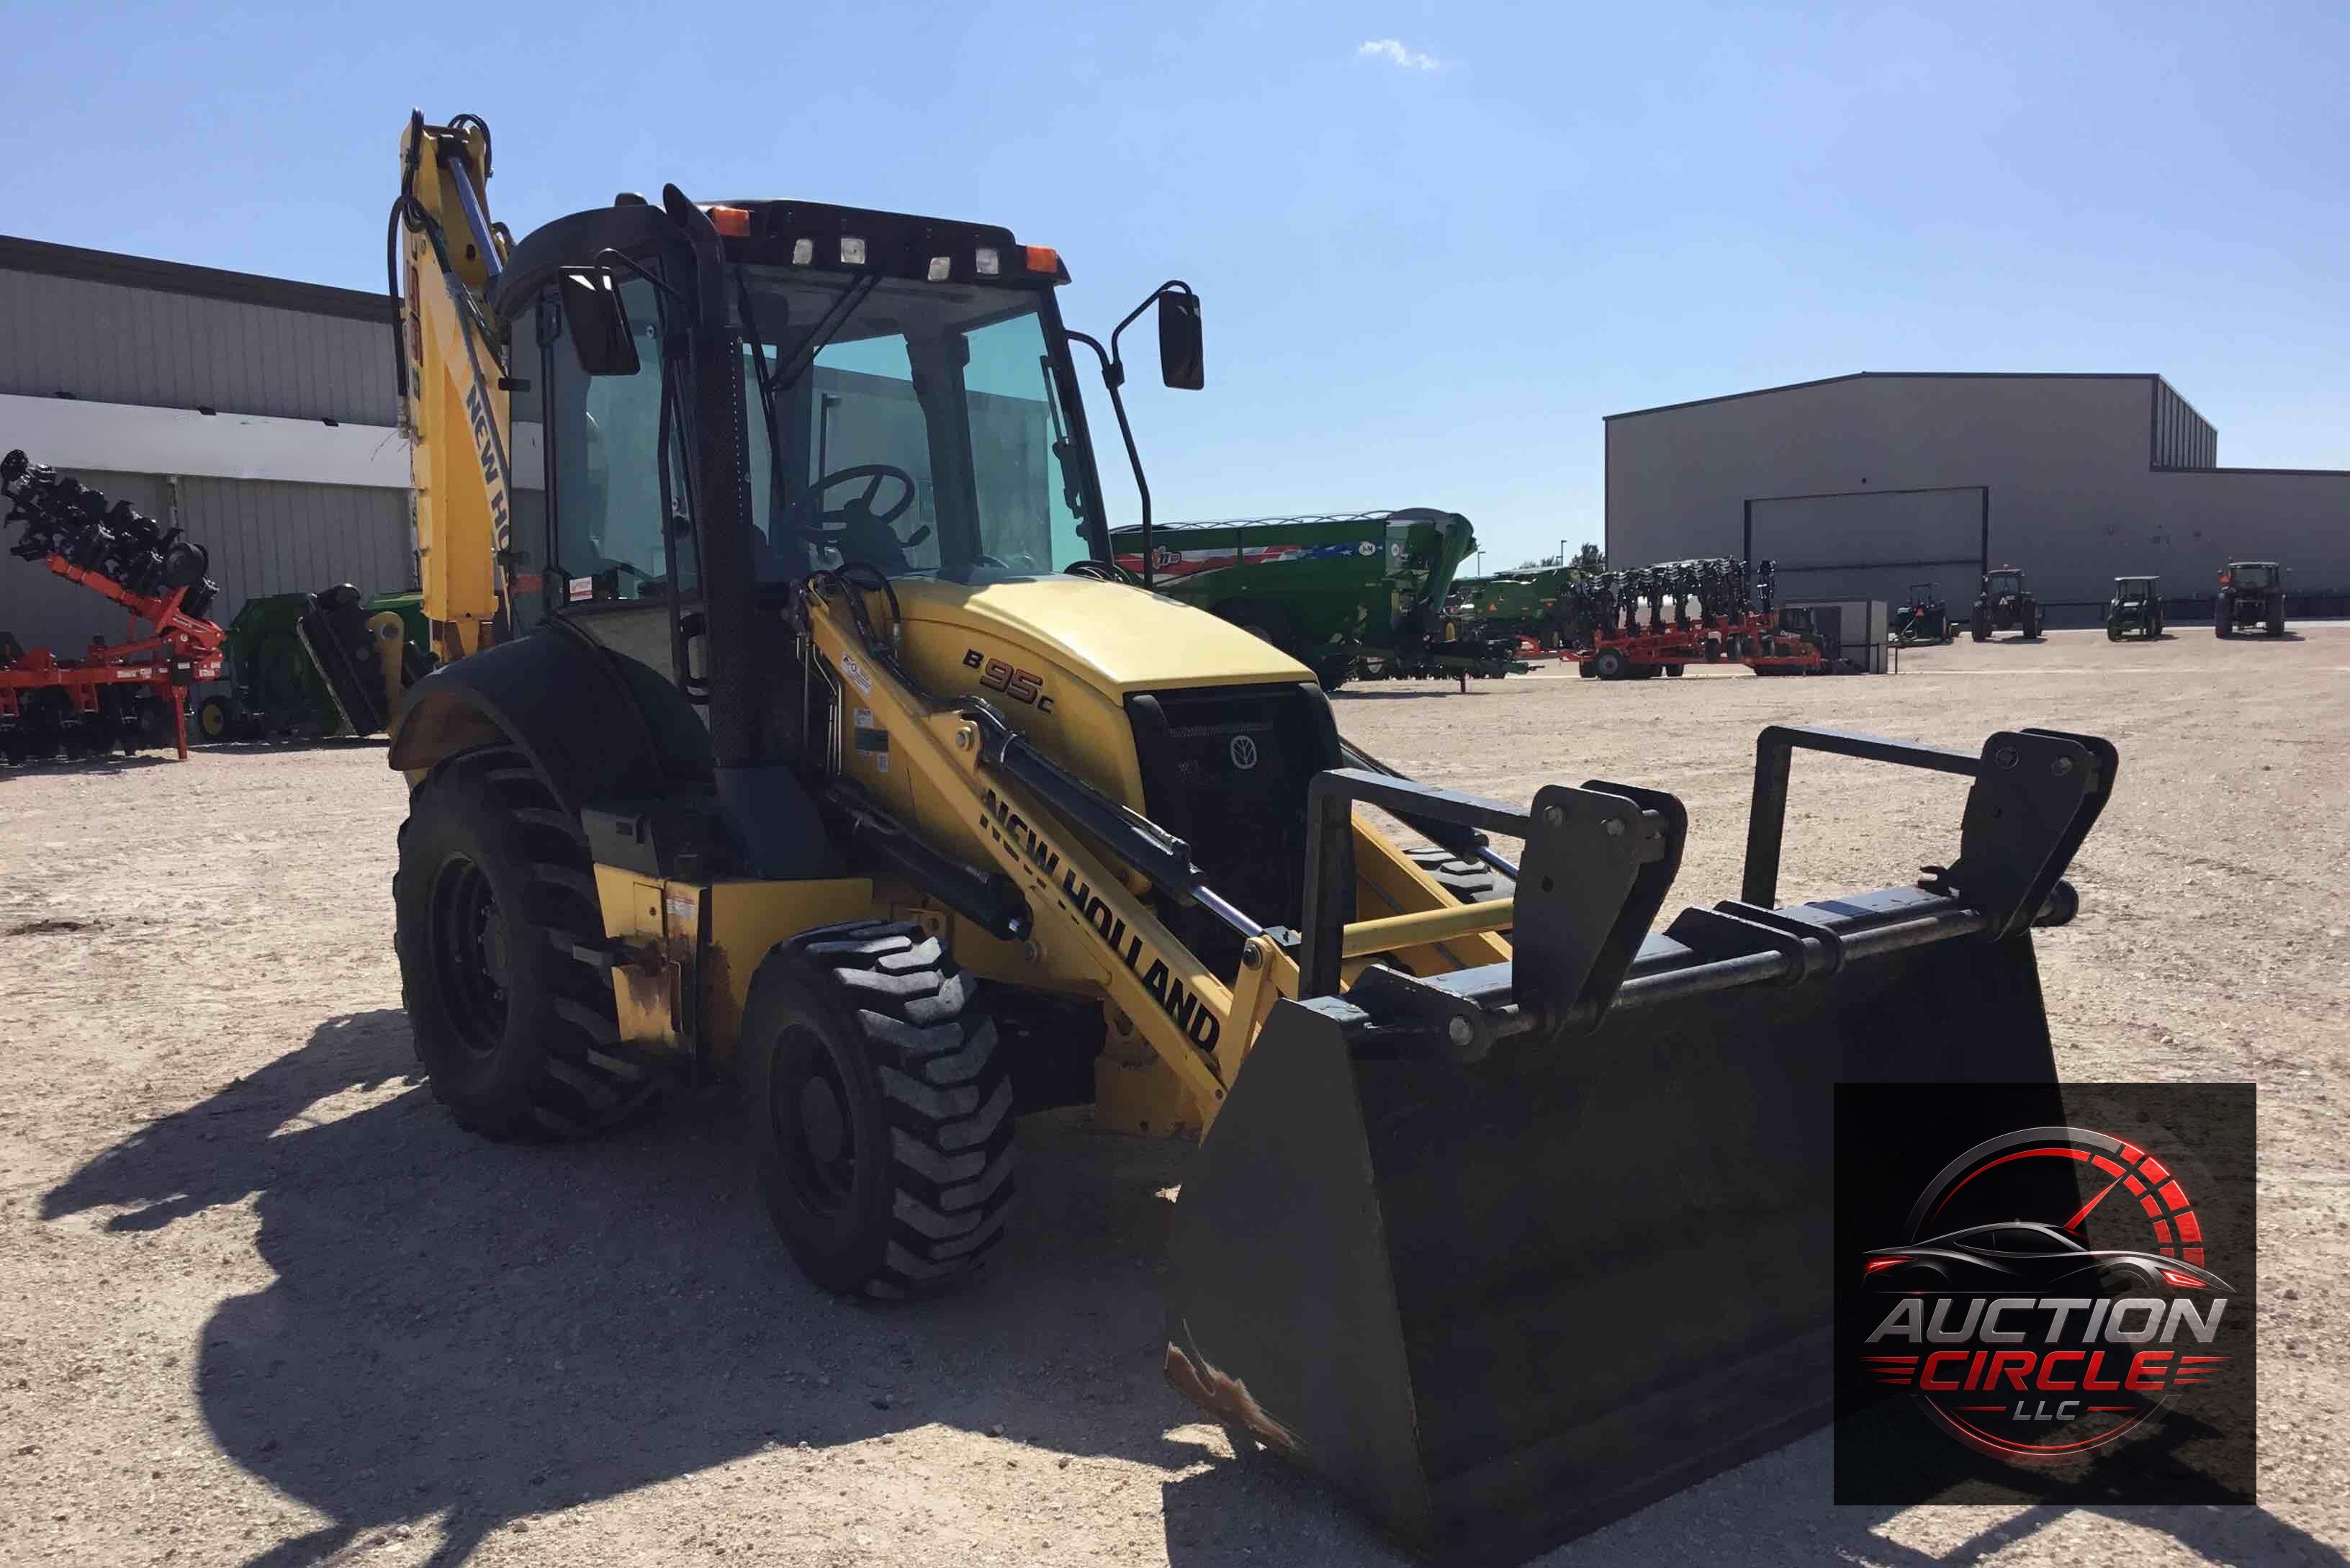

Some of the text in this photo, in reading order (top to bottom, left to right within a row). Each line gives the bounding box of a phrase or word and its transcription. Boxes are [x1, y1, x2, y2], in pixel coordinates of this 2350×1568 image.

[466, 383, 500, 485] NEW
[979, 788, 1221, 1054] NEW HOLLAND
